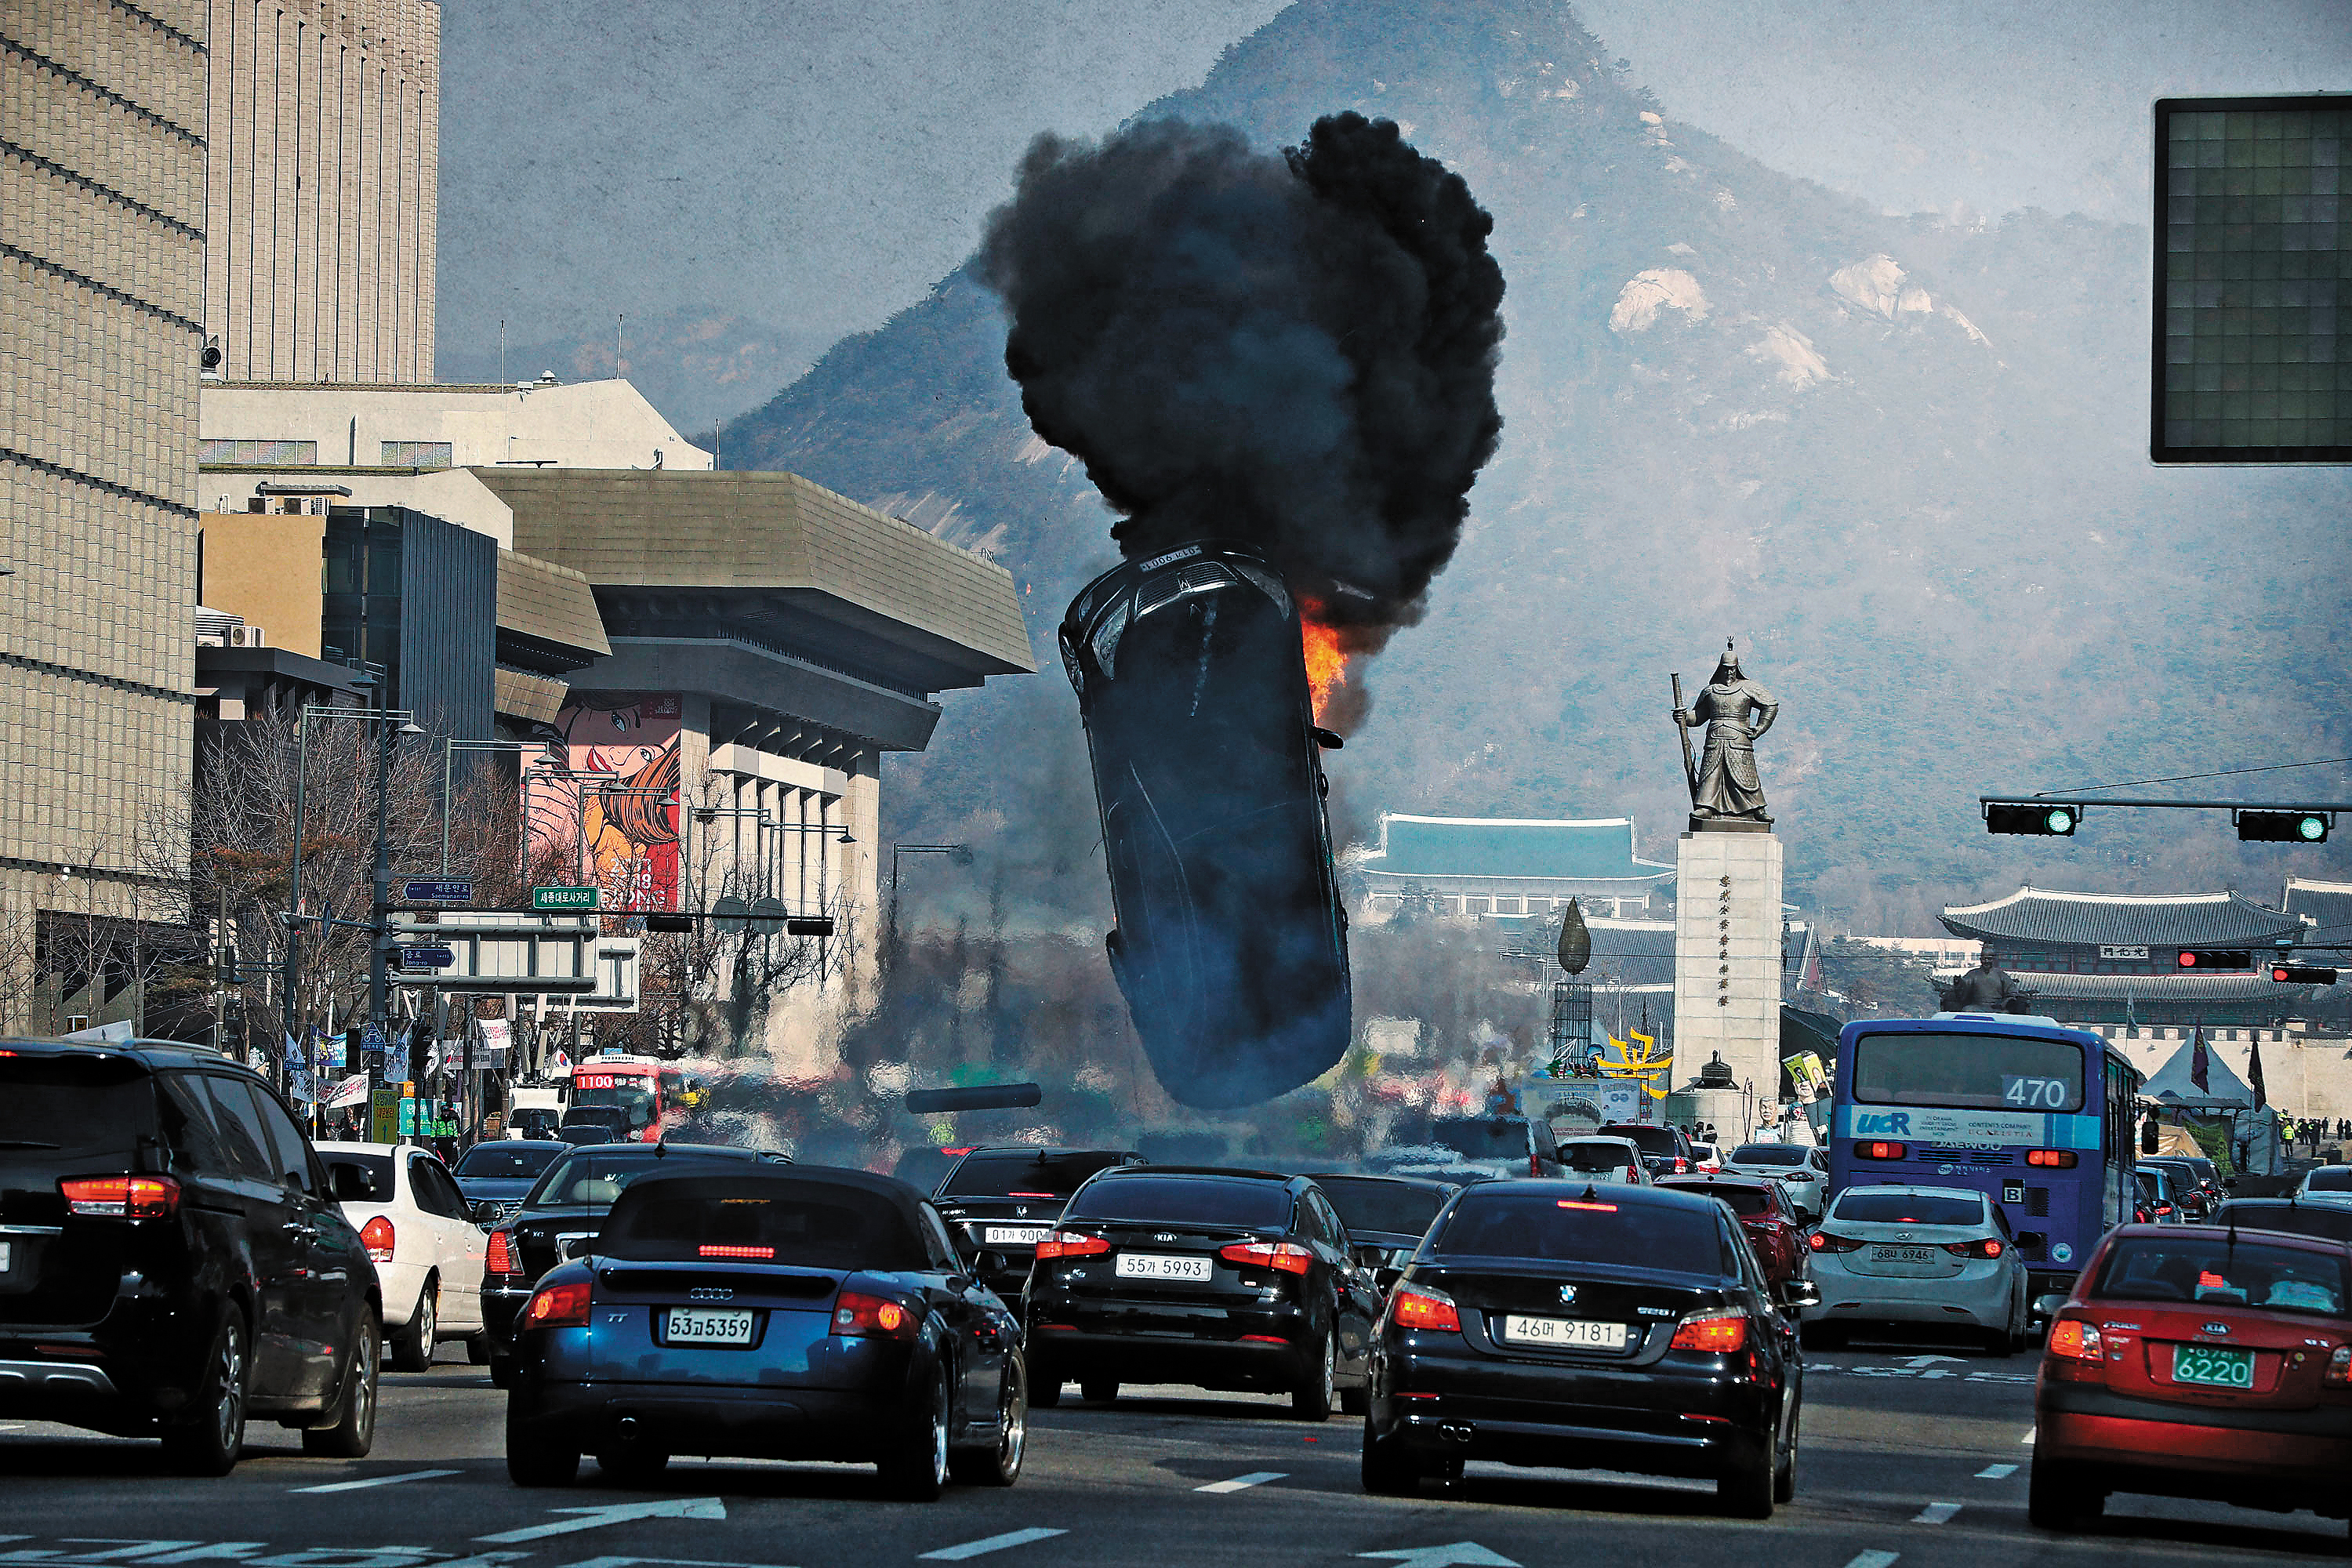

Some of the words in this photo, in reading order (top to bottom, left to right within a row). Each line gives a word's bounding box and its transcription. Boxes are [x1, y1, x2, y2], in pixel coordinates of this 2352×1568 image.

[435, 884, 470, 893] 새문안로
[540, 891, 590, 904] 세종대로사거리
[405, 950, 423, 959] 종로
[580, 1076, 612, 1088] 1100
[2006, 1077, 2066, 1107] 470
[1856, 1112, 1911, 1136] UCR
[2007, 1189, 2019, 1200] B
[993, 1229, 1014, 1240] 01가
[1020, 1229, 1044, 1242] 900
[1156, 1233, 1174, 1242] KIA
[1127, 1258, 1156, 1274] 55가
[1163, 1259, 1202, 1276] 5993
[608, 1313, 628, 1323] TT
[670, 1317, 750, 1338] 53고5359
[1517, 1319, 1554, 1337] 46머
[1565, 1322, 1611, 1342] 9181
[2205, 1324, 2227, 1334] KIA
[2179, 1358, 2248, 1383] 6220
